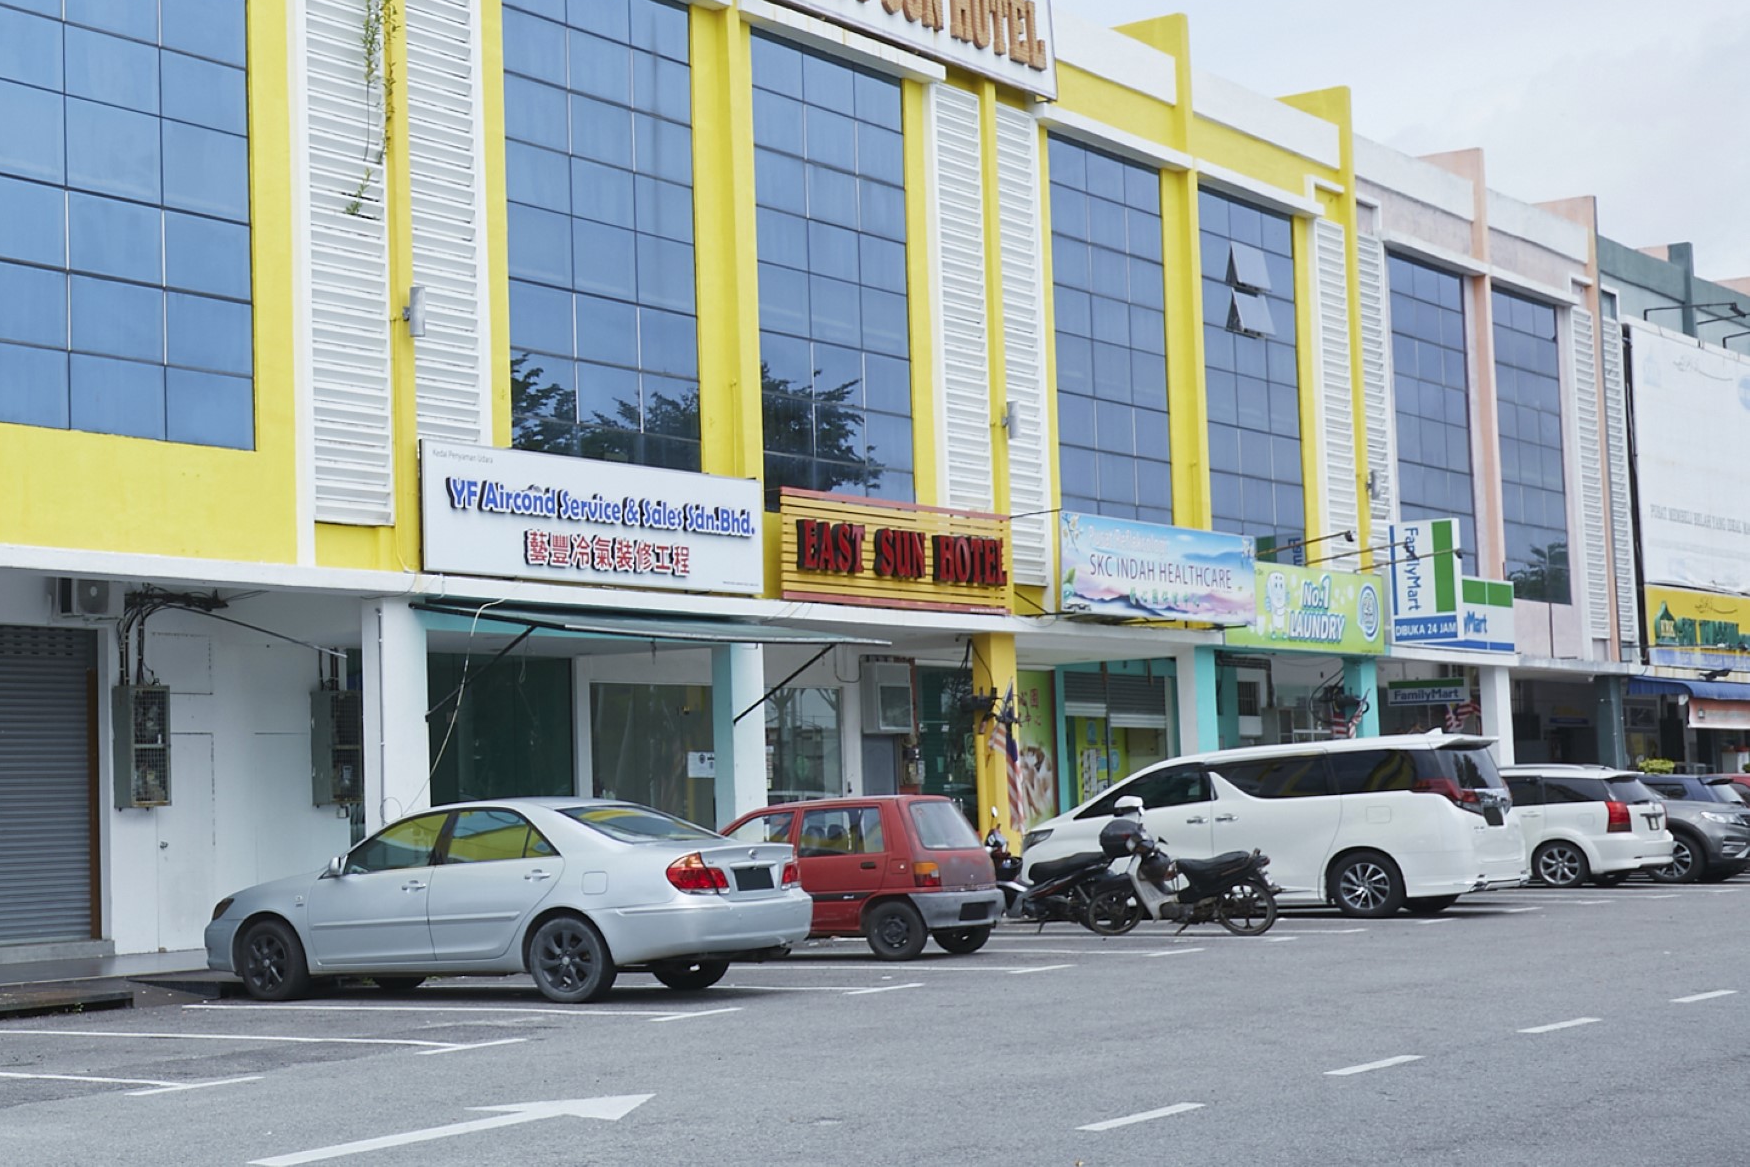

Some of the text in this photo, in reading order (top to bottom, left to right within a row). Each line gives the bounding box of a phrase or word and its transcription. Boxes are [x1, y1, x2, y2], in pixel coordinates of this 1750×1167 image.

[446, 477, 479, 509] YF
[480, 480, 557, 515] Aircond
[558, 489, 622, 523] Service
[624, 497, 639, 524] &
[641, 498, 683, 531] Sales
[526, 529, 691, 577] 藝豐冷氣裝修工程
[796, 519, 1008, 586] EAST SUN HOTEL
[1089, 553, 1232, 589] SKC INDAH HEALTHCARE
[1303, 573, 1331, 609] No.1
[1288, 610, 1345, 643] LAUNDRY
[1396, 621, 1457, 637] DIBUKA 24 JAM
[1394, 688, 1459, 702] FamilyMart
